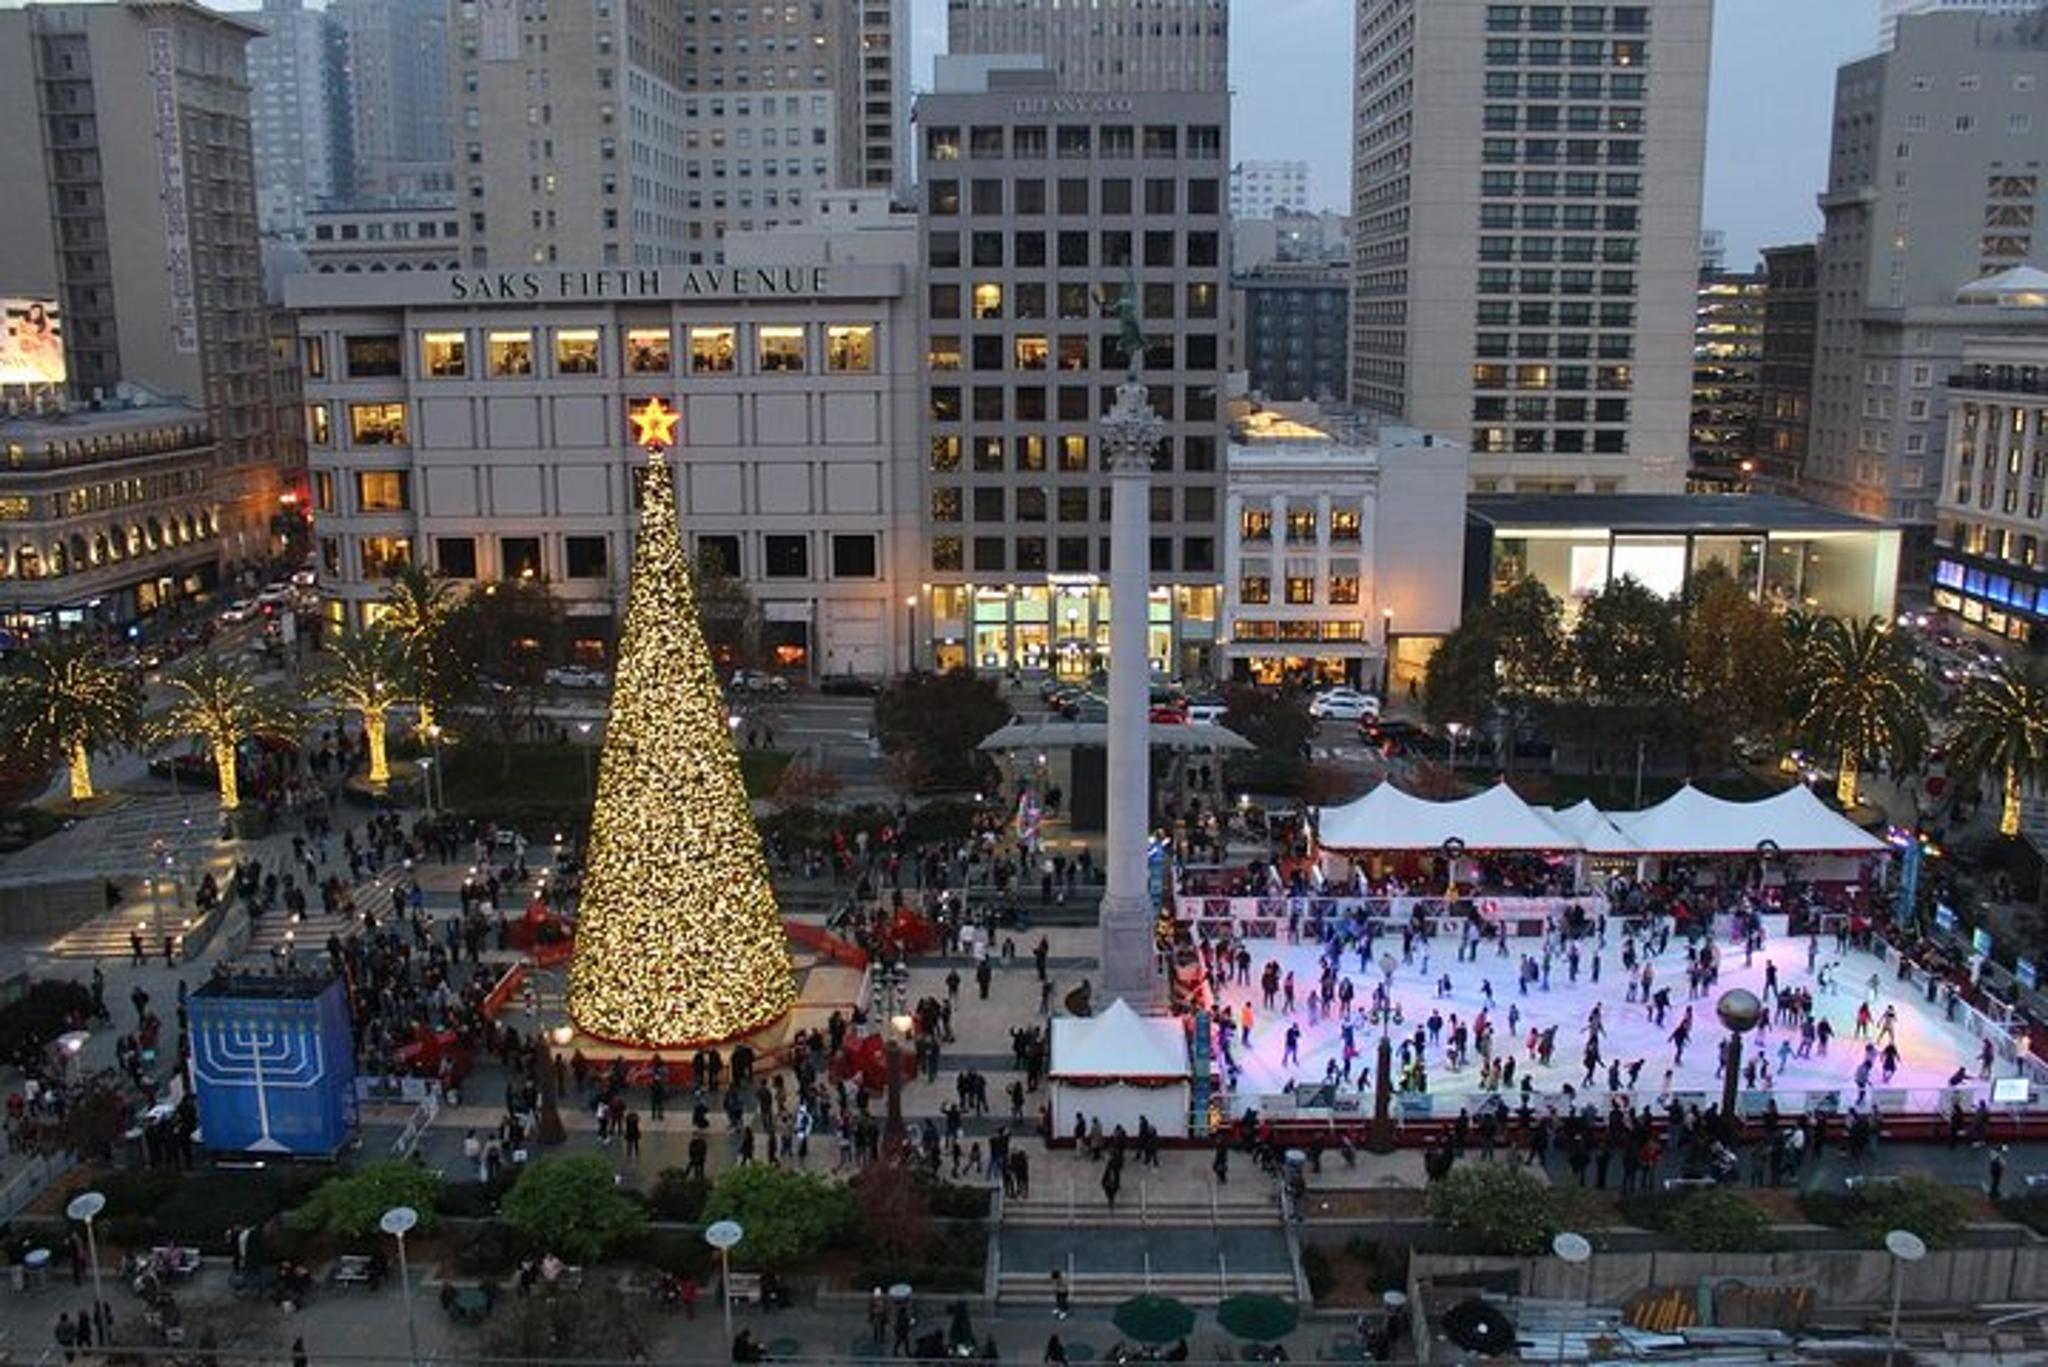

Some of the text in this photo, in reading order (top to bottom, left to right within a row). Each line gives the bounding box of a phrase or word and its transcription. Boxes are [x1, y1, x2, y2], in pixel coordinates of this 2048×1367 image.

[1015, 97, 1087, 114] TIFFANY
[452, 268, 828, 299] SAKS FIFTH AVENUE
